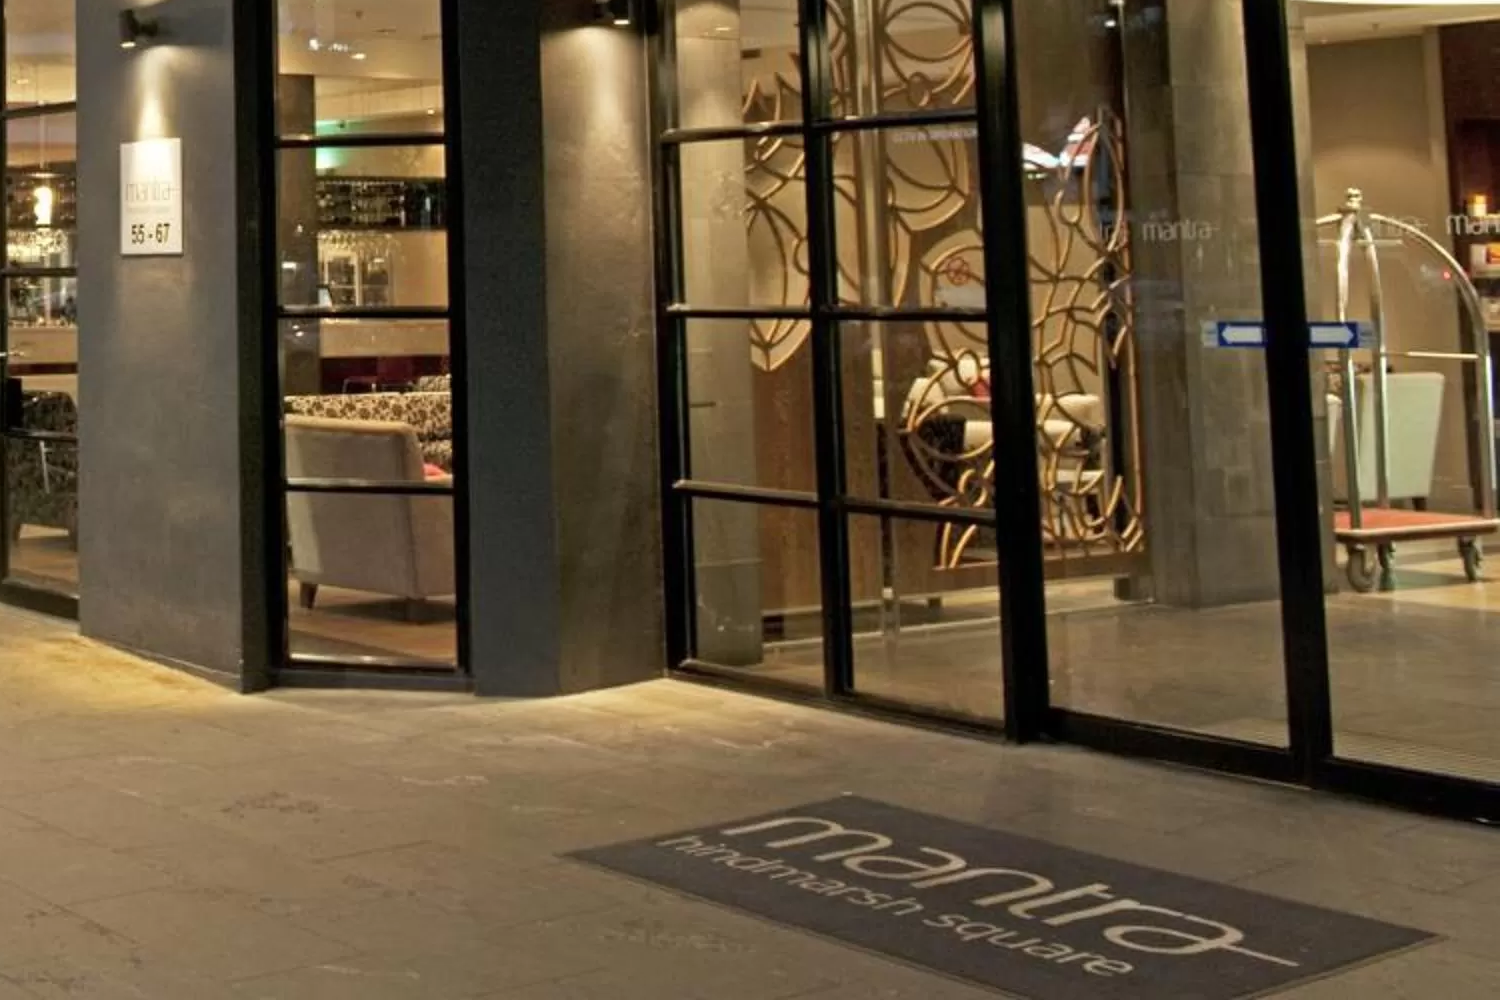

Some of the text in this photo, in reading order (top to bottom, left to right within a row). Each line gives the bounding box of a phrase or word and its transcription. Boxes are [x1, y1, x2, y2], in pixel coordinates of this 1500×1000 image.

[656, 833, 1134, 978] hindmarsh square
[721, 815, 1300, 968] mantra
